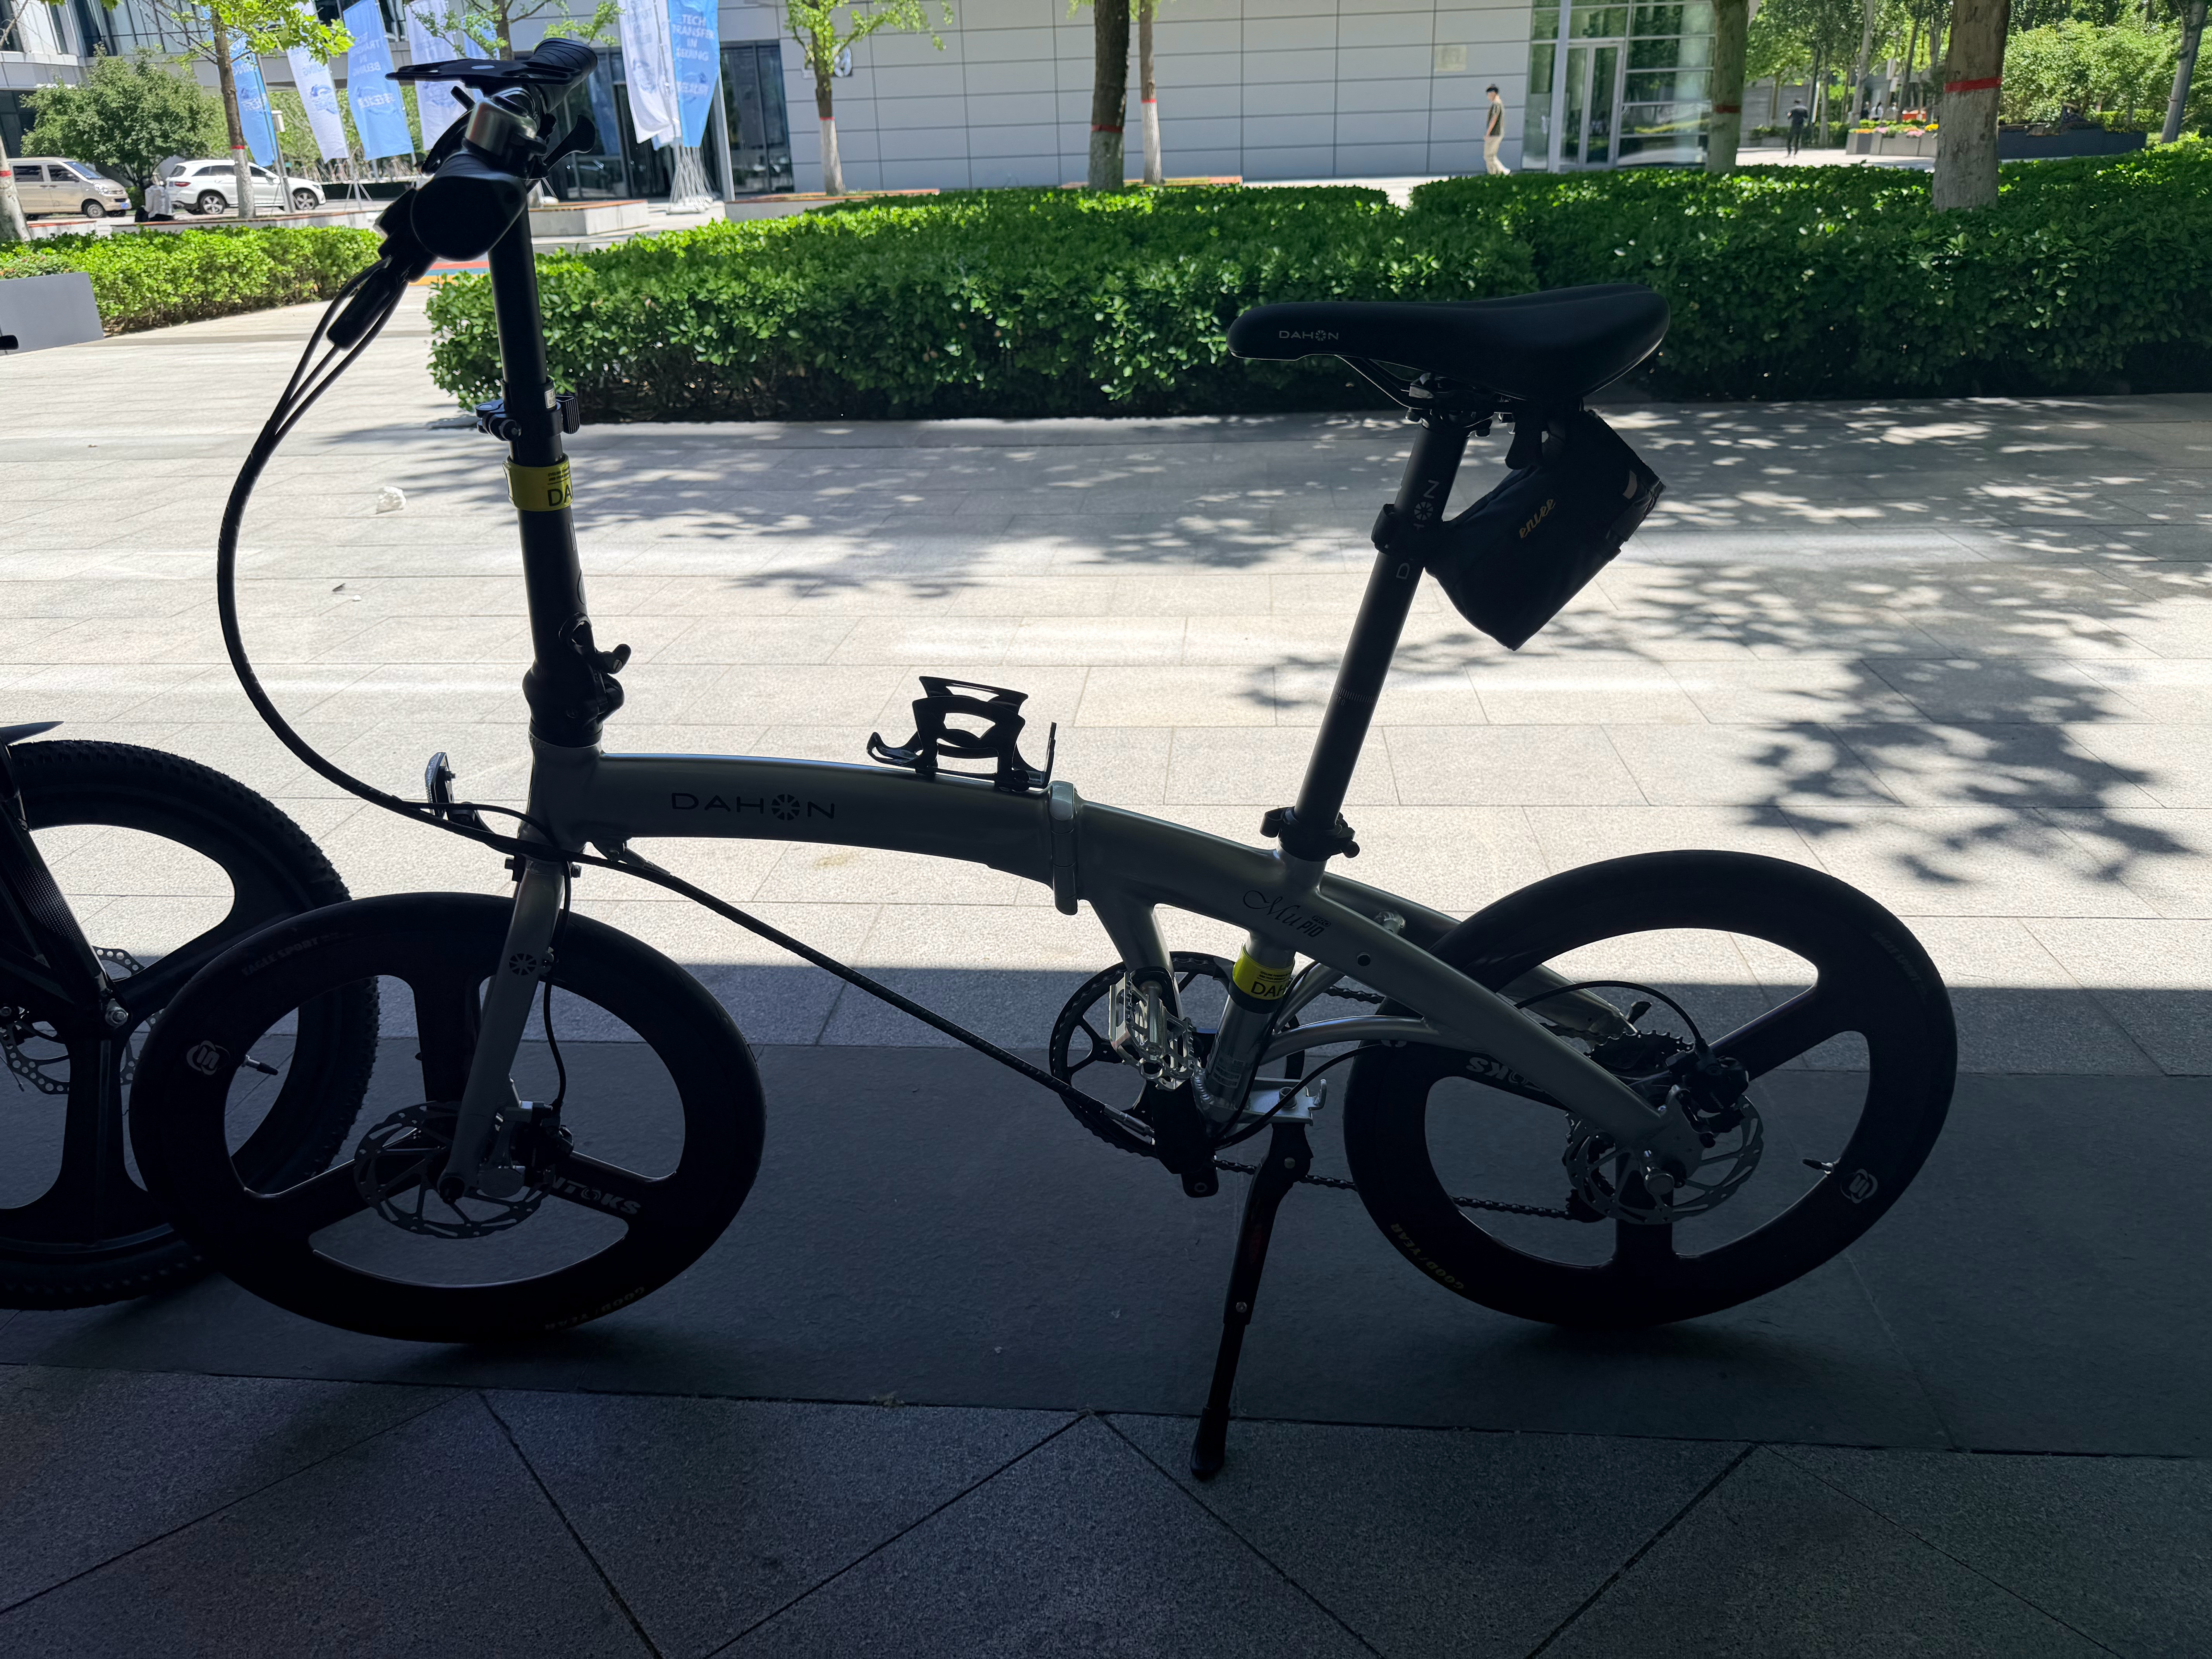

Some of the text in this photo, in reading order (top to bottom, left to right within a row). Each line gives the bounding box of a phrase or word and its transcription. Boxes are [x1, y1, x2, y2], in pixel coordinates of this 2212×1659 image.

[1279, 330, 1339, 341] DAHON
[671, 792, 835, 821] DAHON
[1312, 916, 1331, 927] PRO
